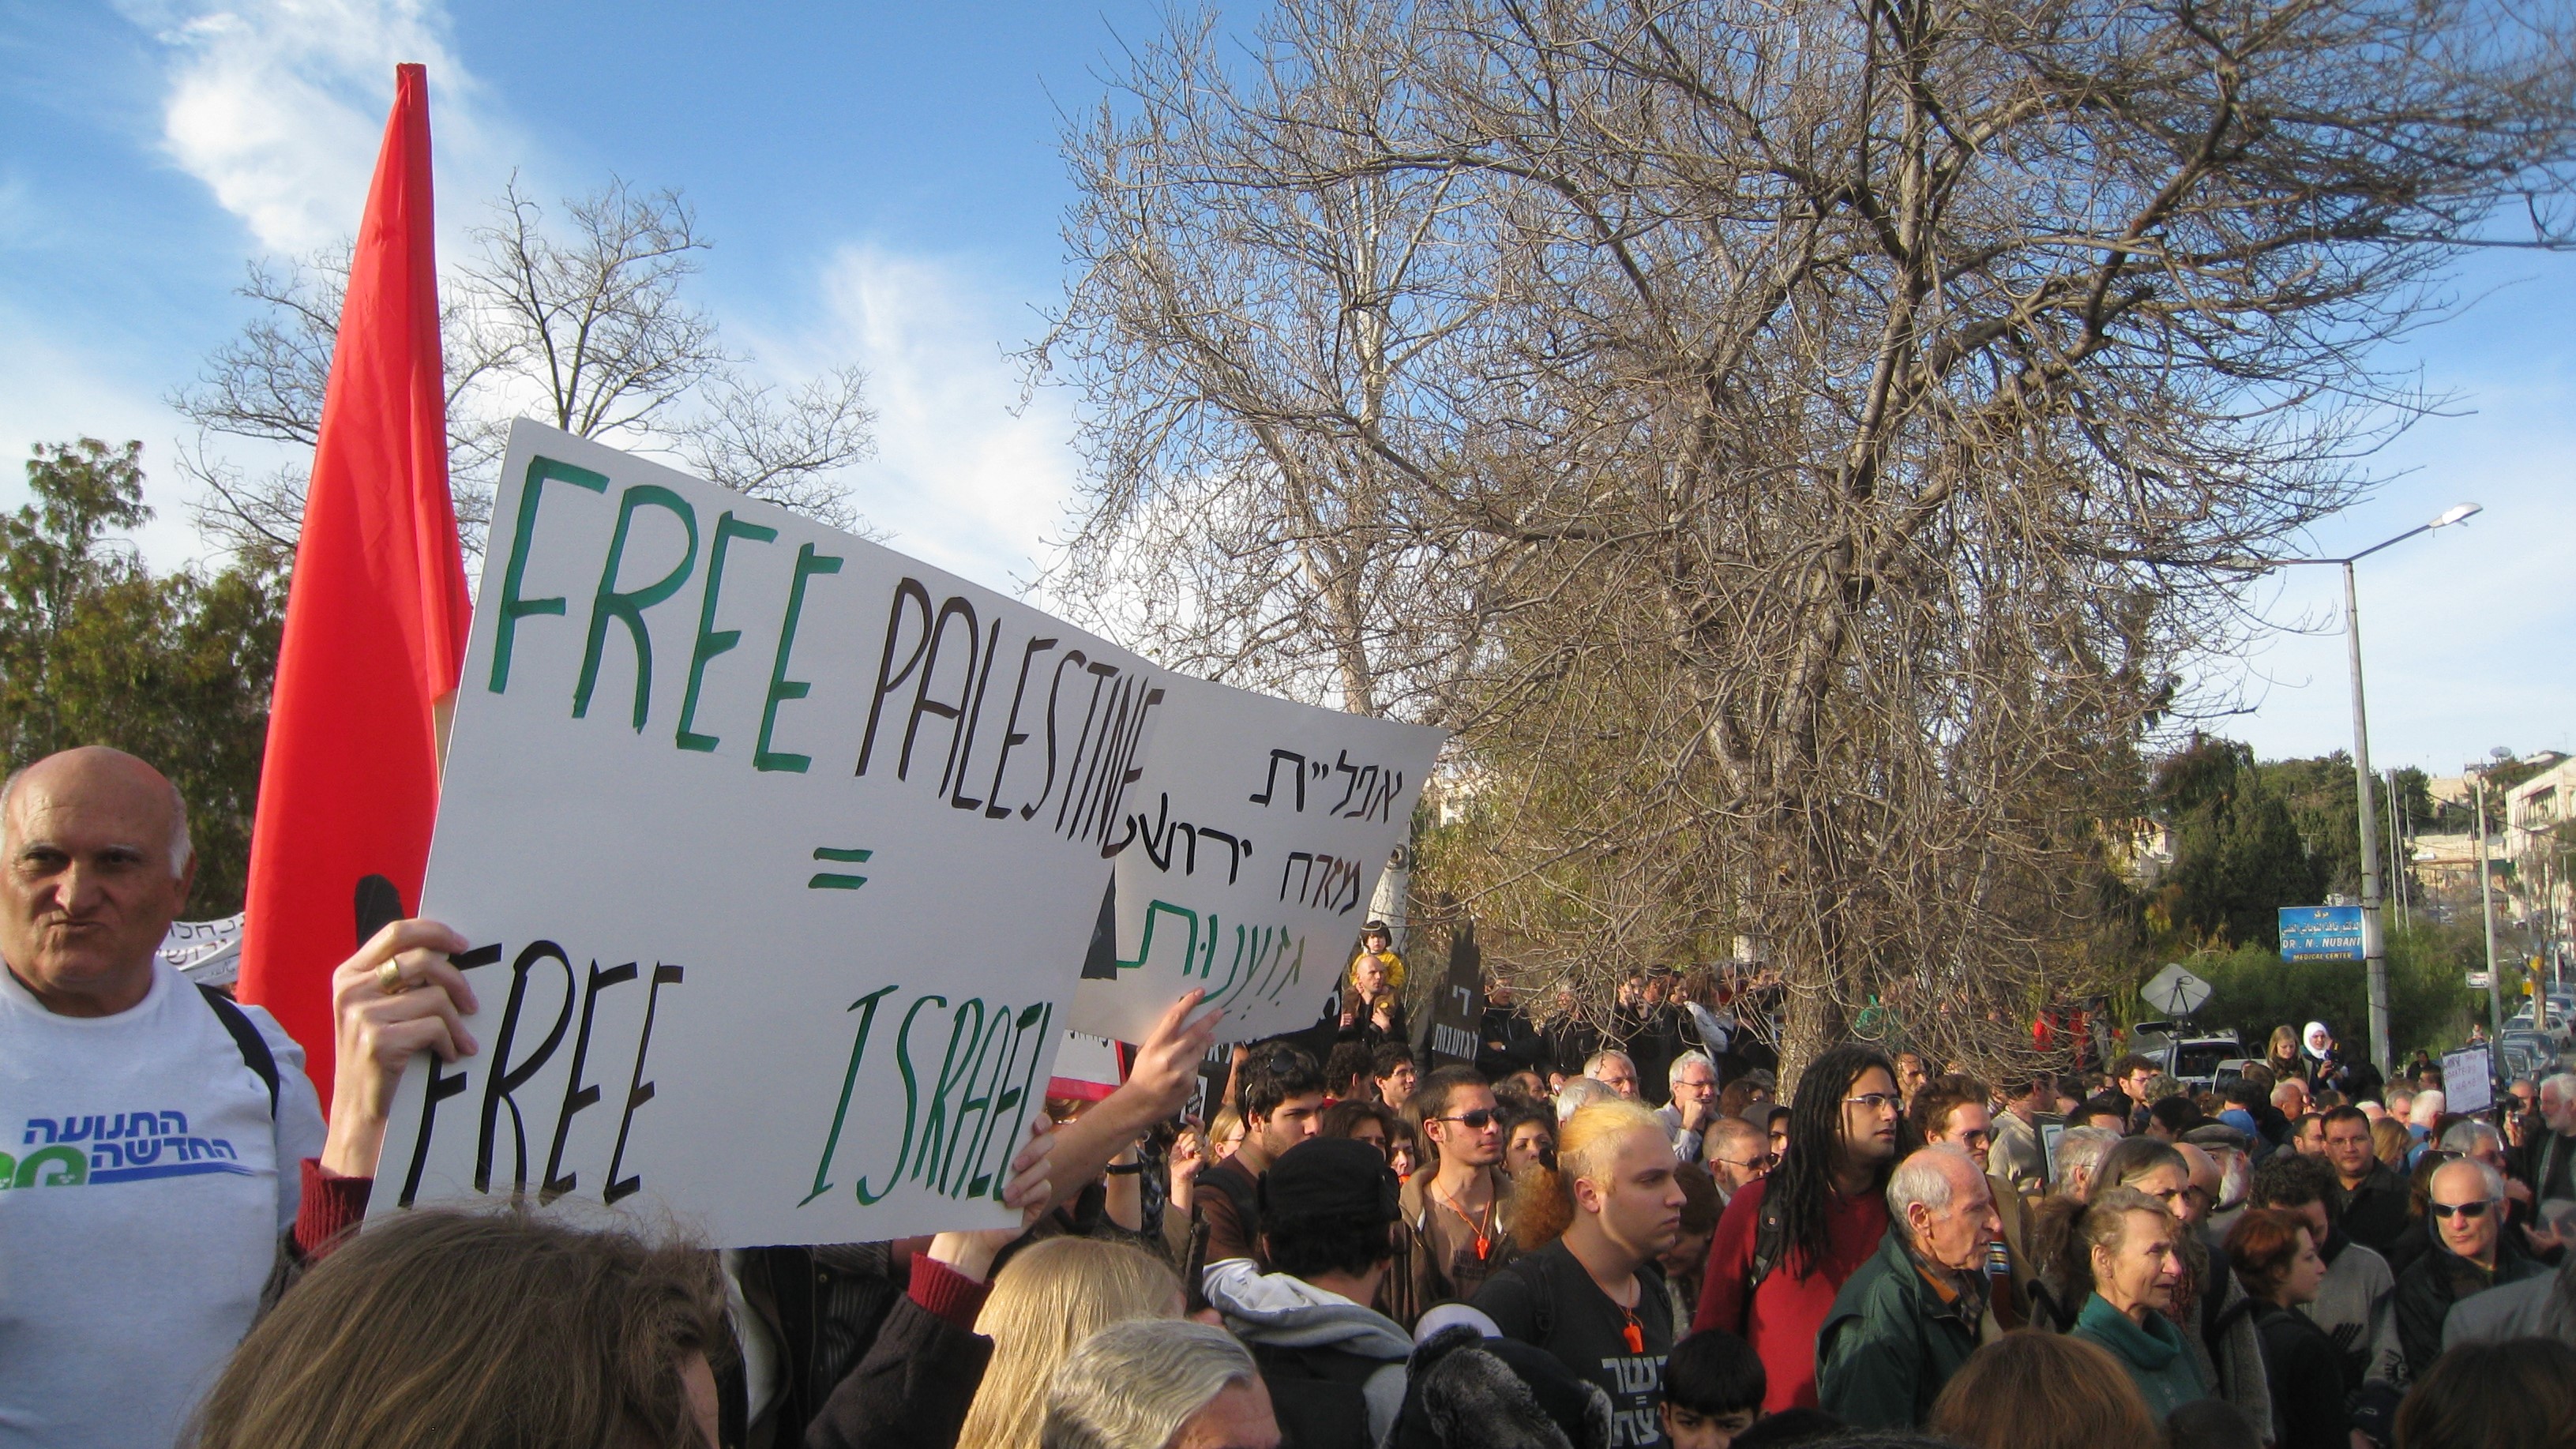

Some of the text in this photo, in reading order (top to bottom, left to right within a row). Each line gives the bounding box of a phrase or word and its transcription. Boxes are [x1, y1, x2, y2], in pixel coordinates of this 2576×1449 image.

[488, 454, 1166, 859] FREE PALESTINE
[1249, 749, 1403, 824] אפליית
[1118, 792, 1253, 886] ירוש
[808, 847, 873, 890] =
[1279, 851, 1361, 916] מזרח
[2323, 937, 2361, 947] NUBANI
[1453, 985, 1471, 1017] די
[397, 940, 1053, 1209] FREE ISRAEL
[24, 1110, 188, 1144] התנועה
[91, 1137, 238, 1168] החדשה
